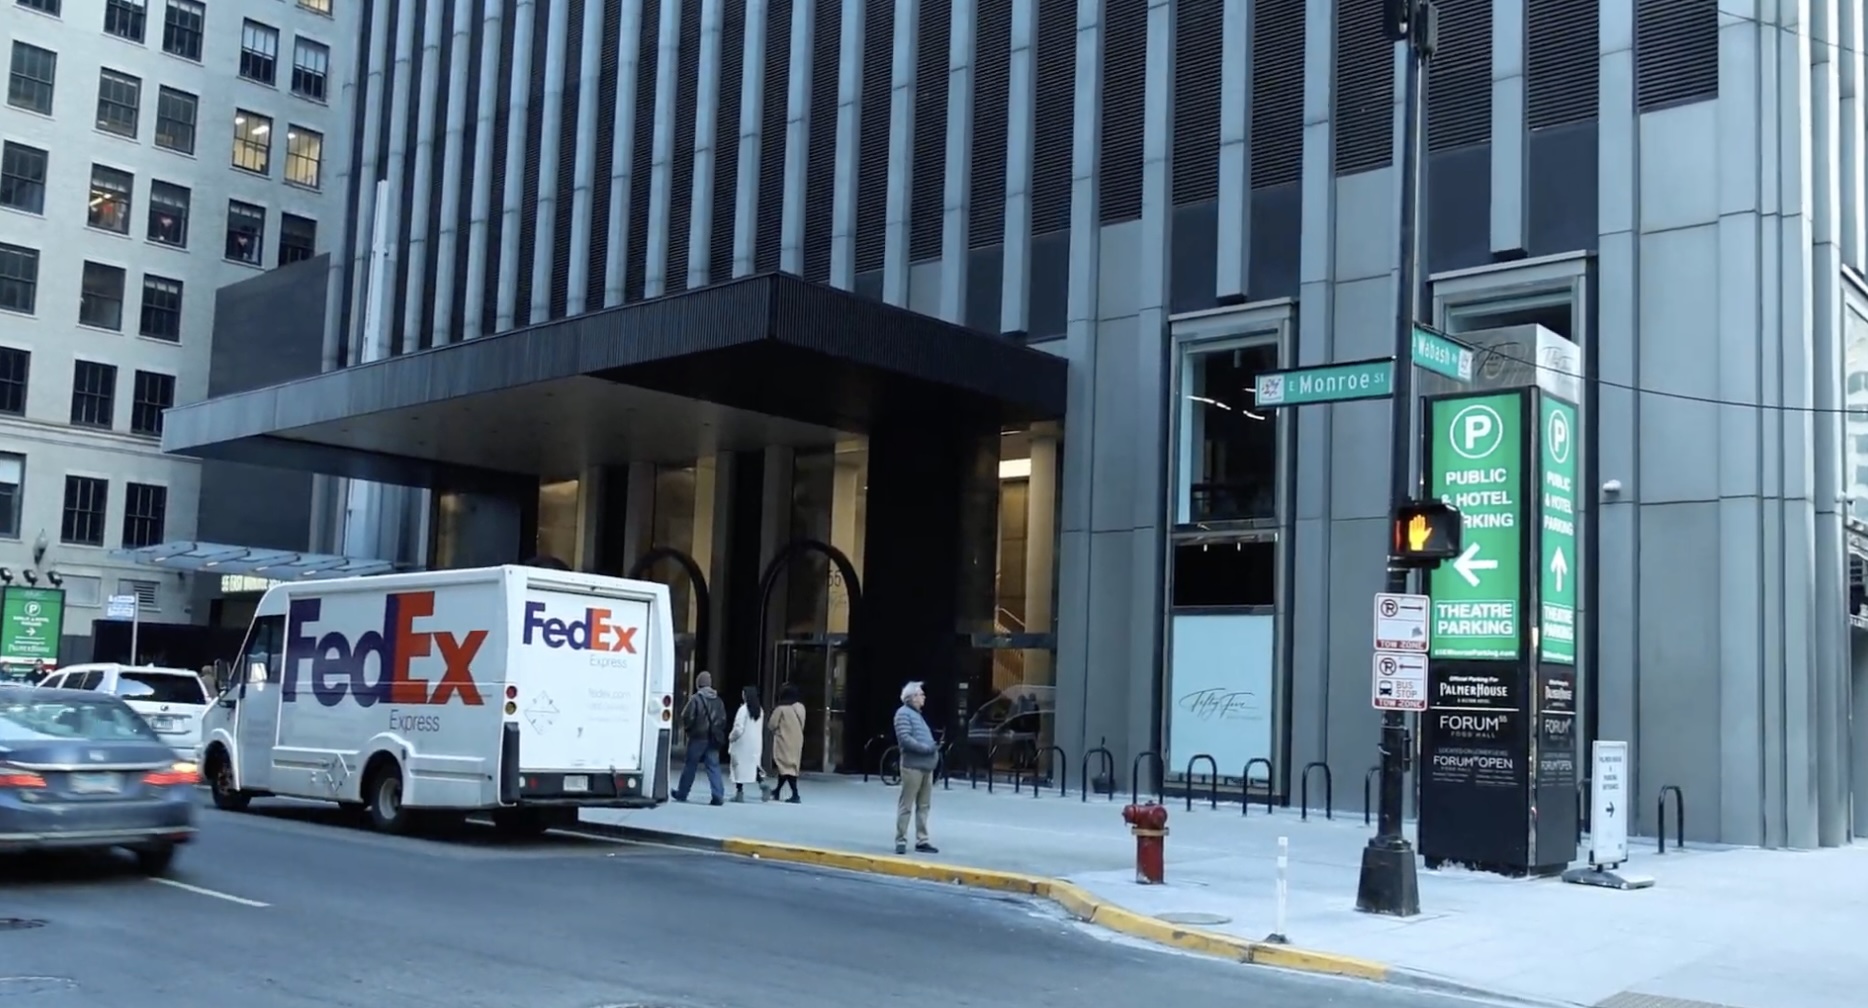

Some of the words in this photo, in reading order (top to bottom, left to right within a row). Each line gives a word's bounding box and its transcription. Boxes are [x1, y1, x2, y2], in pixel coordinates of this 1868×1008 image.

[1418, 334, 1450, 366] Wabash
[1289, 382, 1295, 391] E
[1300, 373, 1370, 395] Monroe
[1464, 414, 1492, 449] P
[1554, 418, 1566, 452] P
[1445, 468, 1507, 486] PUBLIC
[1546, 471, 1572, 492] PUBLIC
[1456, 490, 1512, 508] HOTEL
[1552, 495, 1573, 514] HOTEL
[1463, 513, 1514, 529] RKING
[1543, 515, 1574, 536] PARKING
[1437, 603, 1513, 618] THEATRE
[523, 601, 638, 654] FedEx
[1437, 620, 1513, 634] PARKING
[282, 591, 489, 708] FedEx
[1400, 642, 1424, 650] ZONE
[589, 655, 627, 668] Express
[1396, 681, 1414, 689] BUS
[1396, 690, 1418, 698] STOP
[1399, 701, 1423, 709] ZONE
[389, 709, 440, 733] Express
[1478, 756, 1513, 769] OPEN
